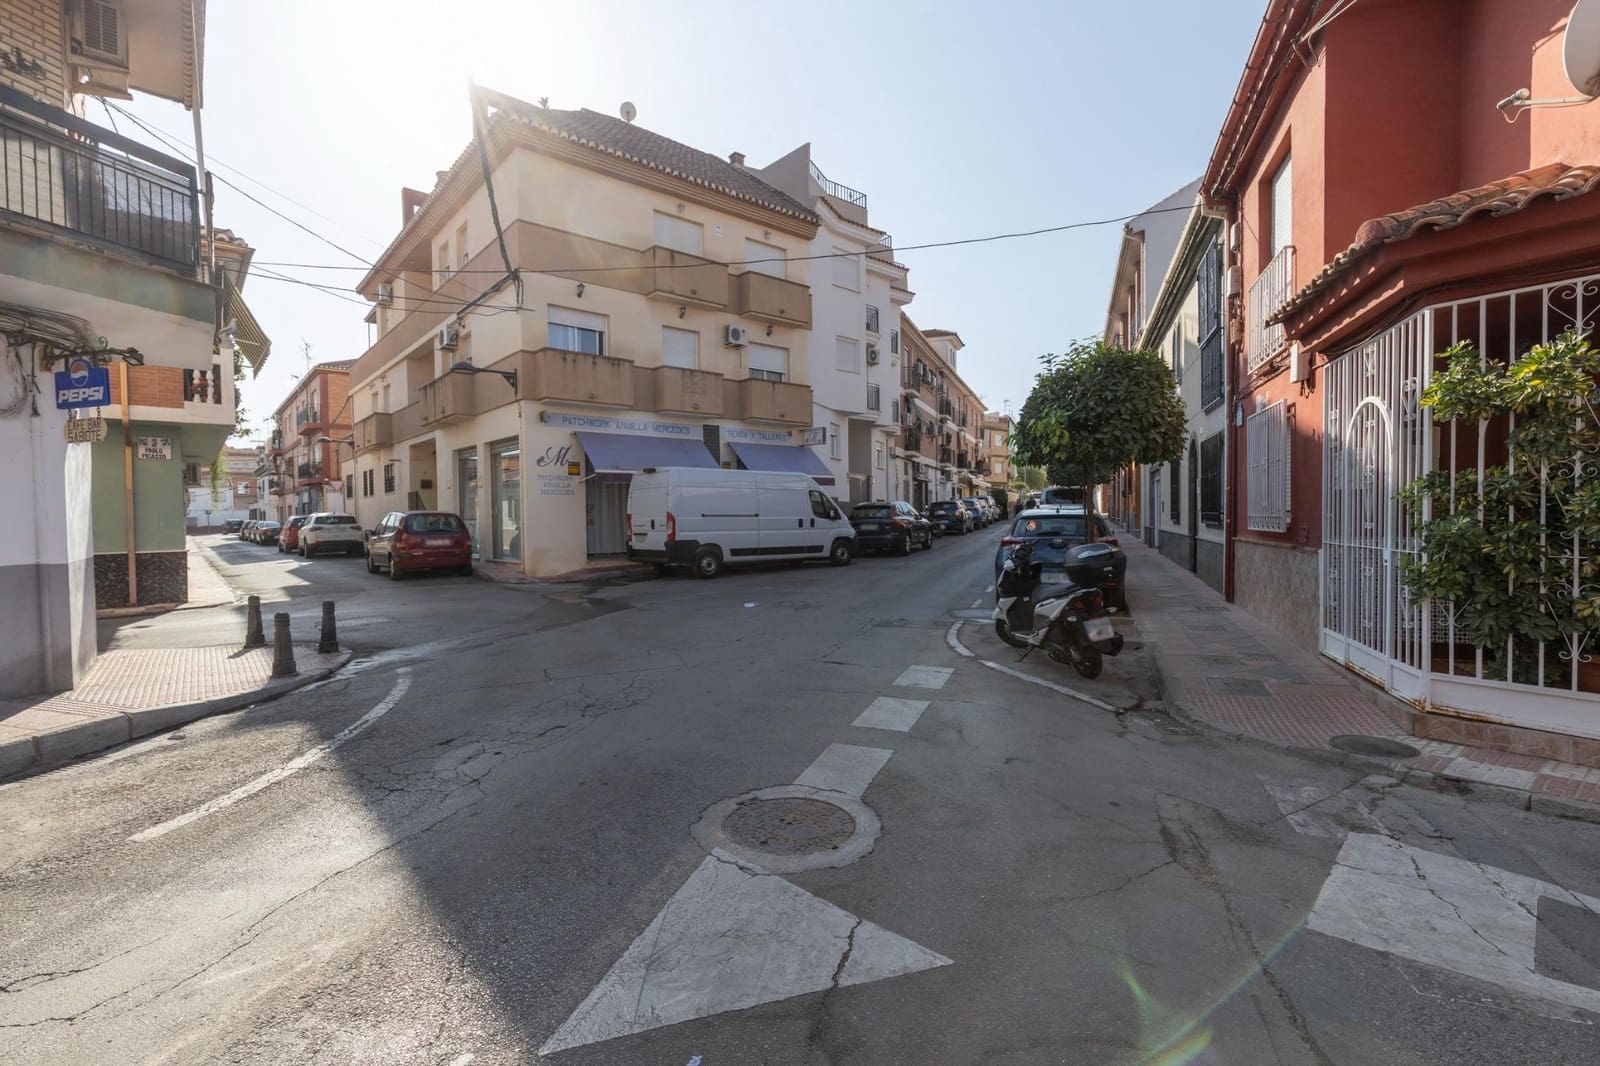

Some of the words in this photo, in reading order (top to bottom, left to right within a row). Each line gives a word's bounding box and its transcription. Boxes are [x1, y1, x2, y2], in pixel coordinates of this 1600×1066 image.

[58, 386, 104, 403] PEPSI
[87, 416, 102, 430] BAR
[562, 416, 609, 428] PATCHWORK
[652, 423, 690, 435] MERCEDES
